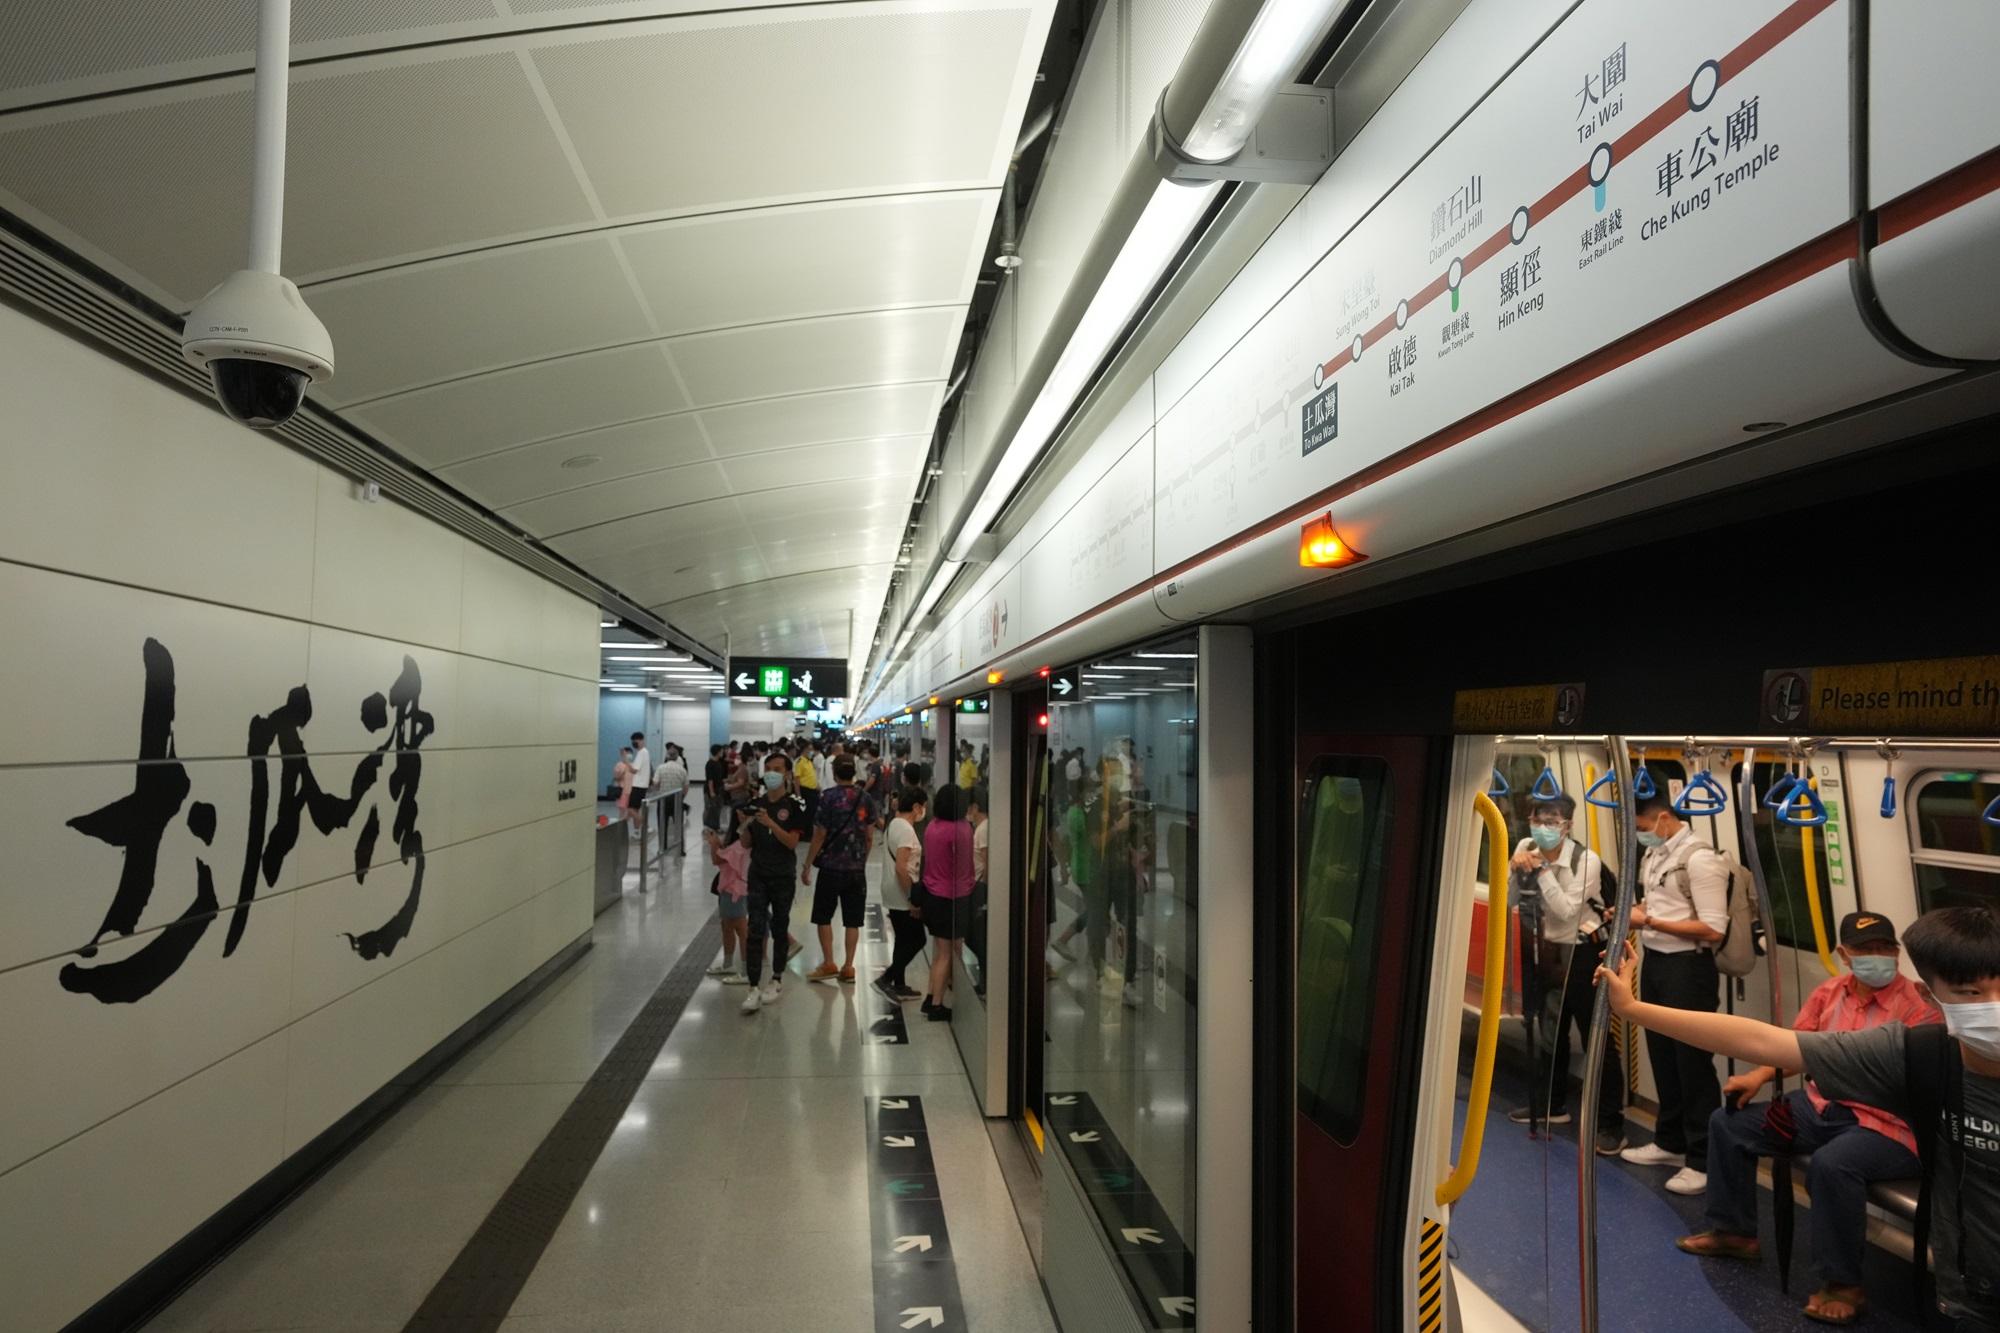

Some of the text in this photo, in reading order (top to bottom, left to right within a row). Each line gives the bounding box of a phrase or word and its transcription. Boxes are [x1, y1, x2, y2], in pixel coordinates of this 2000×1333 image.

[1575, 41, 1627, 122] 大圍
[1577, 92, 1624, 144] Tai Wai
[1655, 95, 1760, 198] 車公廟
[1430, 175, 1482, 243] 鑽石山
[1640, 143, 1780, 241] Che Kung Temple
[1429, 208, 1483, 265] Diamond Hill
[1578, 233, 1624, 270] East Rail Line
[1500, 245, 1542, 307] 顯徑
[1498, 292, 1544, 331] Hin Keng
[1451, 336, 1464, 352] Tong
[1463, 330, 1474, 344] Line
[1390, 371, 1416, 399] Kai Tak
[1303, 389, 1337, 435] 土瓜灣
[1304, 438, 1312, 450] To
[1311, 432, 1323, 447] Kwa
[1322, 424, 1336, 440] Wan
[1820, 687, 1890, 710] Please
[1897, 680, 1964, 709] mind
